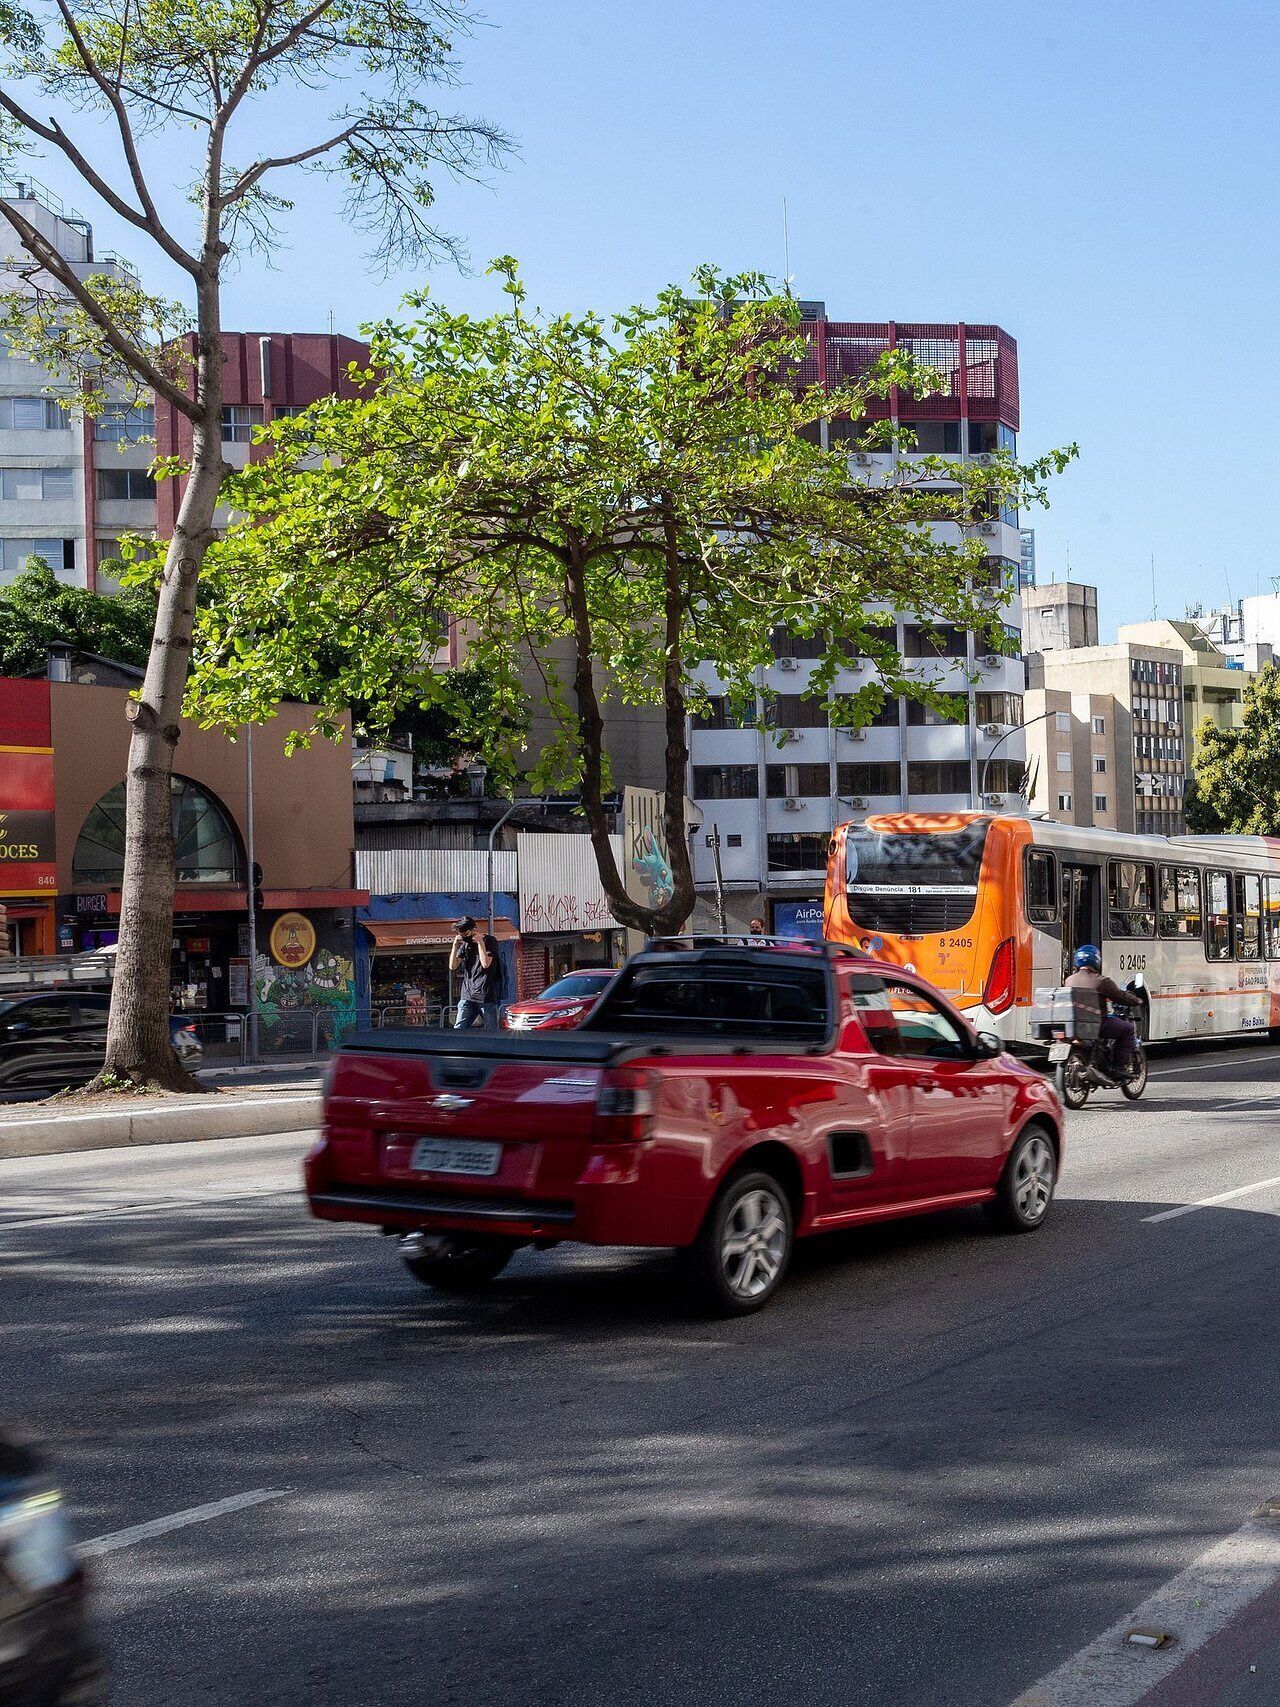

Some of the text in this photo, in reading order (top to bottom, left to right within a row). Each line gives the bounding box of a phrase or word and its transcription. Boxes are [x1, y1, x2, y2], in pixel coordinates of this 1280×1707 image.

[38, 876, 55, 885] 840
[853, 885, 874, 893] Disque
[875, 885, 904, 893] Denúncia
[77, 895, 107, 912] BURGER
[406, 936, 441, 945] EMPÓRIO
[940, 938, 972, 947] 8 2405
[1119, 954, 1146, 970] 8 2405
[1242, 1015, 1265, 1028] Piso Baixo
